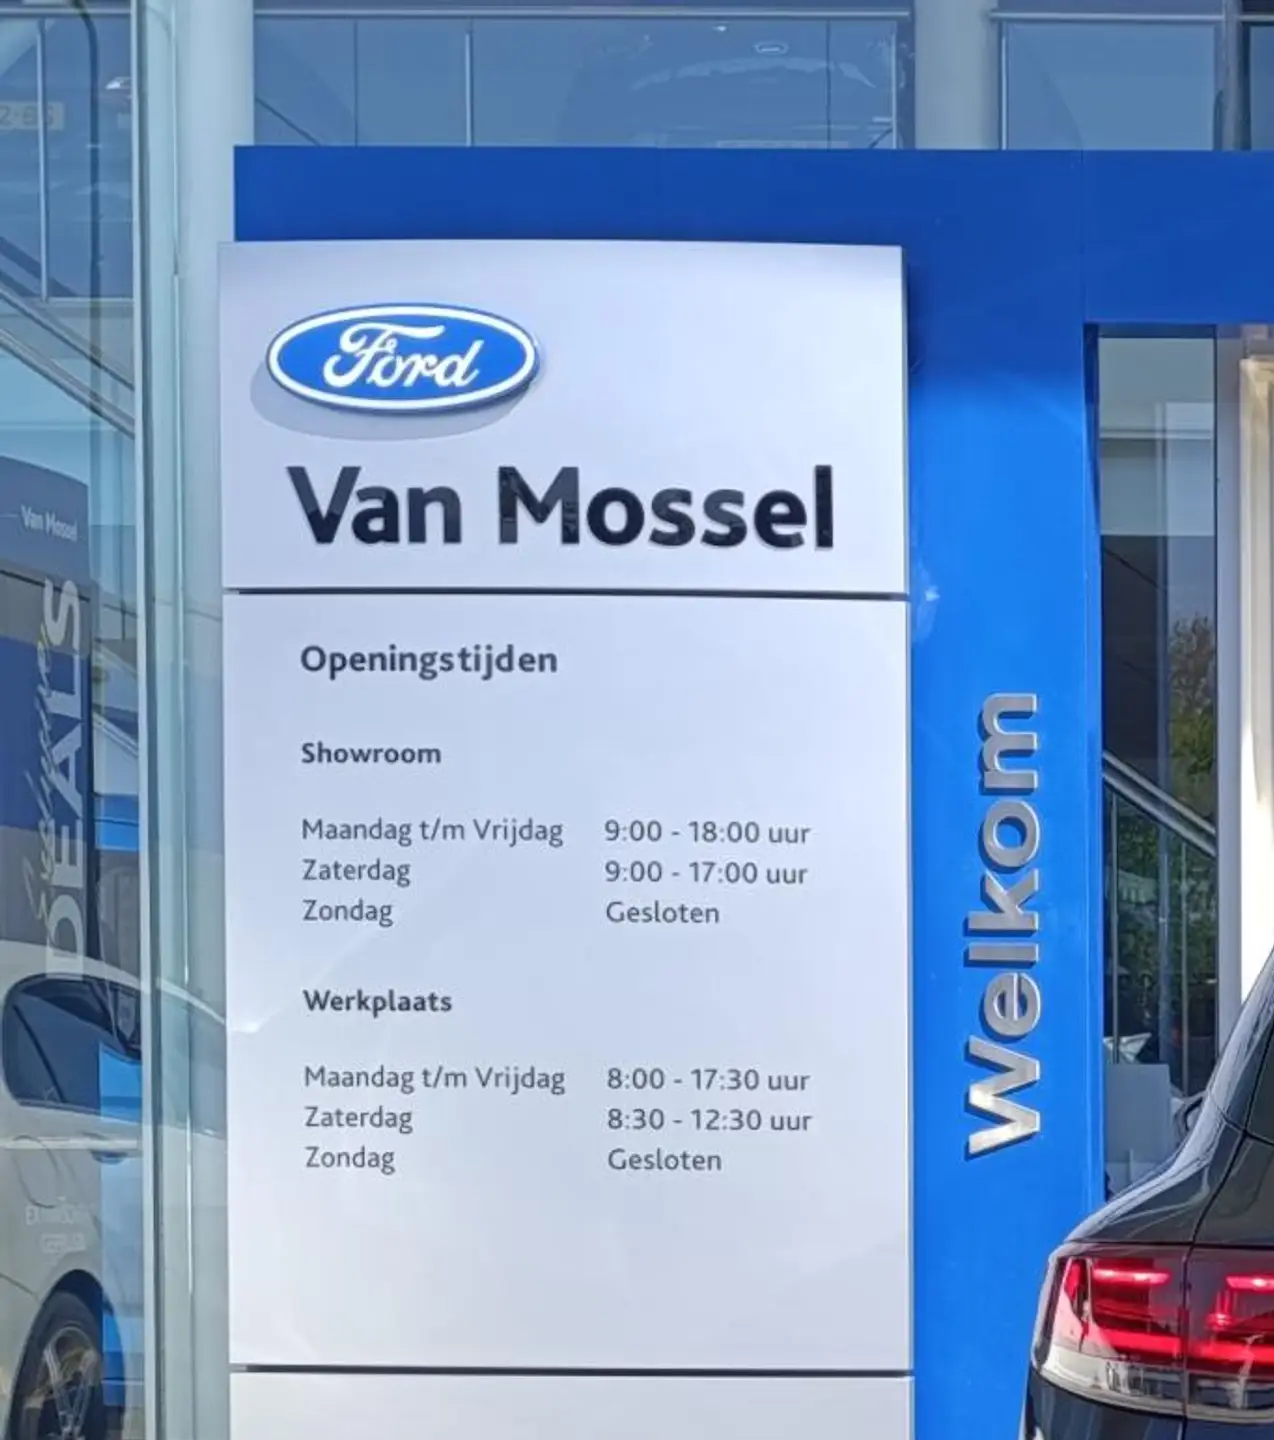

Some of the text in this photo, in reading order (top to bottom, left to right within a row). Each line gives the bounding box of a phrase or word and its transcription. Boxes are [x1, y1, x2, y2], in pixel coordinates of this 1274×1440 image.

[323, 322, 484, 387] Ford
[286, 465, 833, 549] Van Mossel
[301, 644, 557, 681] Openingstijden
[302, 741, 441, 763] Showroom
[44, 576, 84, 980] DEALS
[302, 817, 563, 848] Maandag t/m Vrijdag
[605, 820, 662, 842] 9:00
[689, 821, 760, 843] 18:00
[769, 827, 810, 843] uur
[303, 858, 410, 888] Zaterdag
[605, 860, 662, 882] 9:00
[689, 862, 758, 884] 17:00
[767, 868, 807, 884] uur
[303, 898, 393, 928] Zondag
[606, 900, 719, 923] Gesloten
[964, 691, 1041, 1160] Welkom
[303, 989, 452, 1018] Werkplaats
[305, 1065, 565, 1095] Maandag t/m Vrijdag
[607, 1068, 665, 1089] 8:00
[691, 1069, 759, 1090] 17:30
[768, 1075, 810, 1091] uur
[305, 1105, 413, 1134] Zaterdag
[608, 1108, 664, 1130] 8:30
[691, 1109, 762, 1130] 12:30
[771, 1116, 812, 1131] uur
[305, 1145, 395, 1175] Zondag
[608, 1148, 721, 1170] Gesloten
